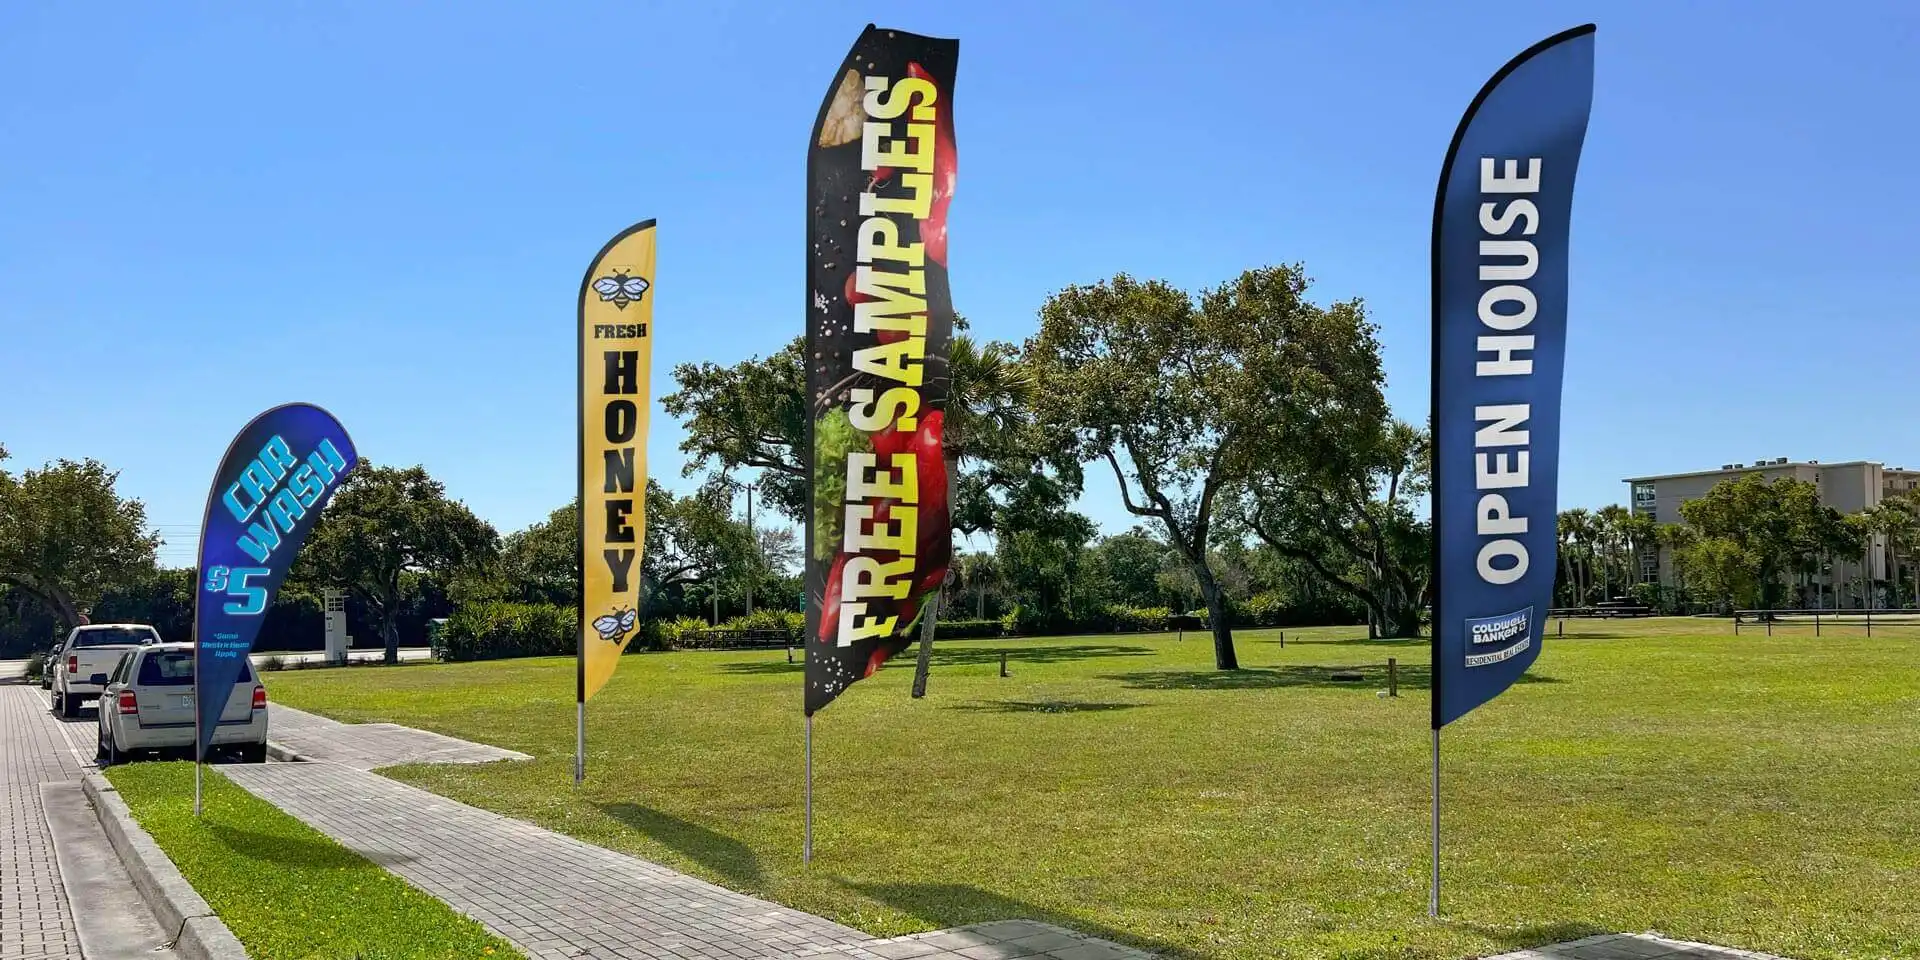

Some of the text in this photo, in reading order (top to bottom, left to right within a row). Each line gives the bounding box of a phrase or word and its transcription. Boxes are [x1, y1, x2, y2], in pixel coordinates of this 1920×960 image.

[594, 323, 647, 339] FRESH
[836, 76, 938, 648] FREE SAMPLES
[1475, 157, 1543, 585] OPEN HOUSE
[222, 434, 298, 523] CAR
[236, 438, 347, 564] WASH
[603, 351, 639, 593] HONEY
[205, 565, 271, 615] $5
